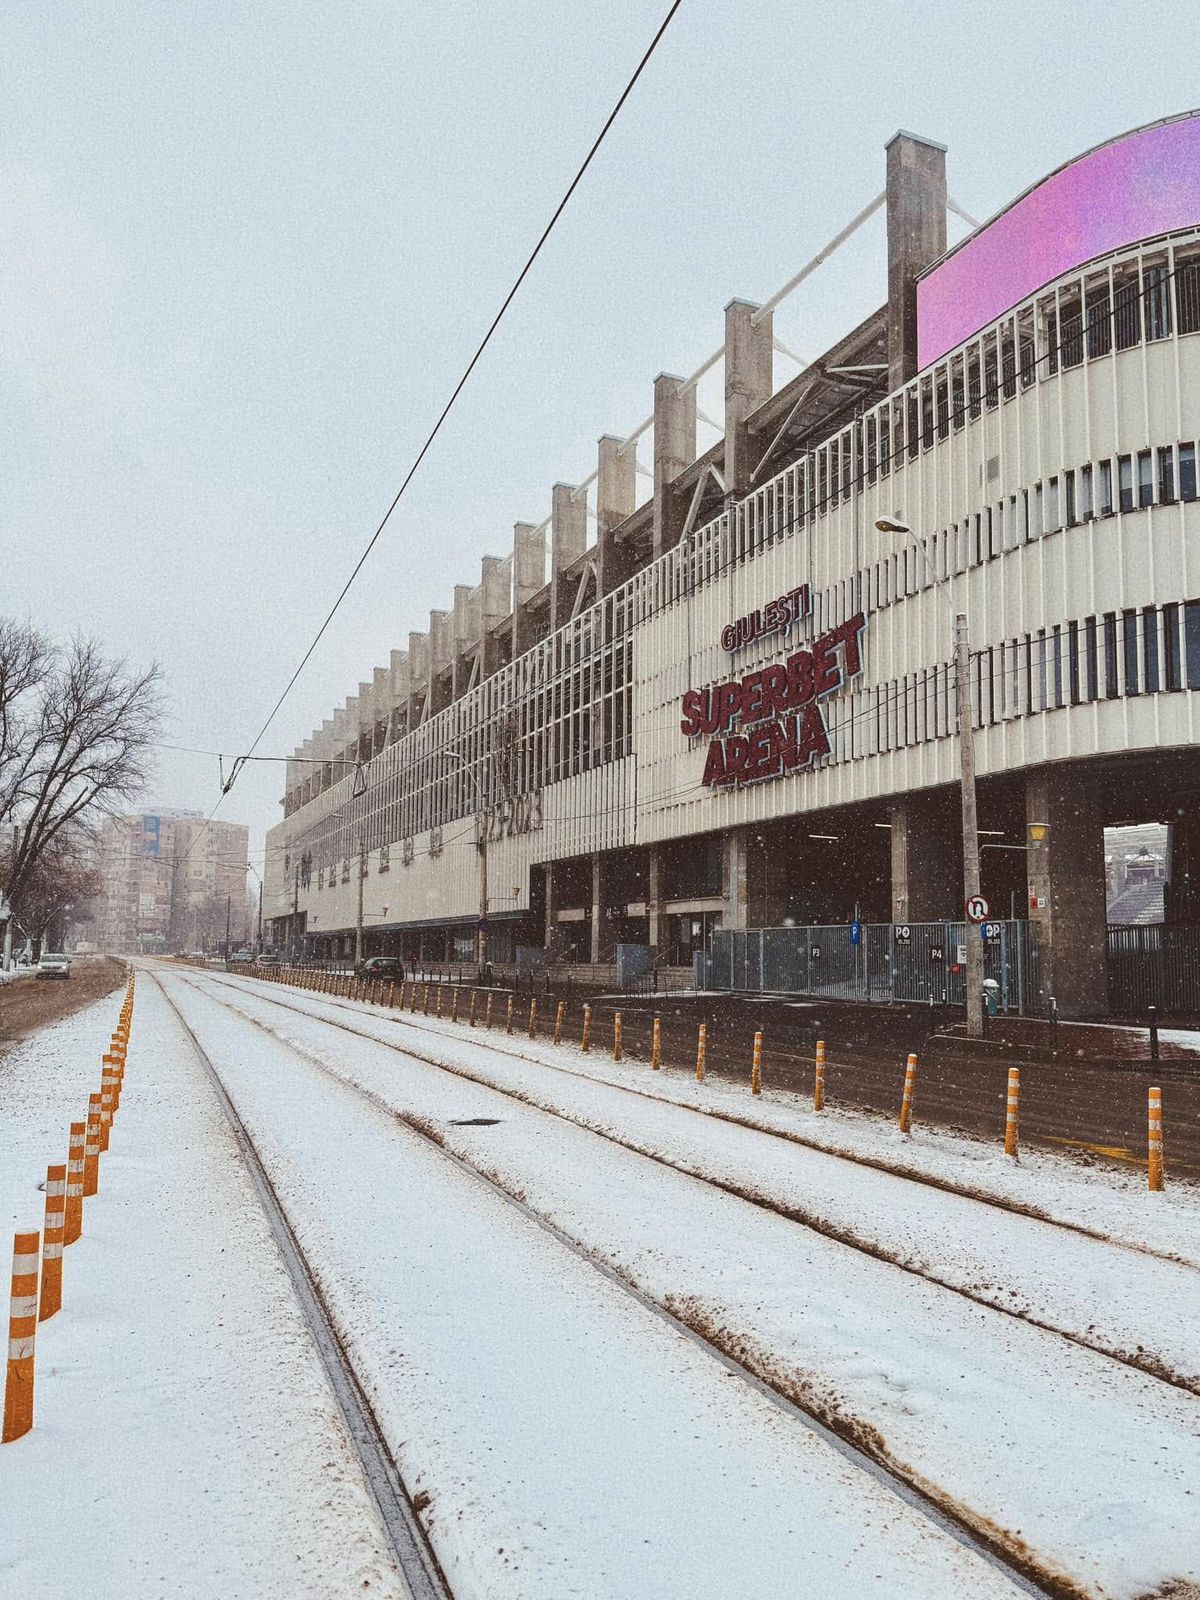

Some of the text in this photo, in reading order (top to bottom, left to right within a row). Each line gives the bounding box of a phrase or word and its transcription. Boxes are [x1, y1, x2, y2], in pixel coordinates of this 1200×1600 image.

[681, 612, 867, 738] SUPERBET
[702, 704, 833, 788] ARENA
[852, 926, 858, 940] P
[812, 948, 820, 957] P3
[932, 950, 942, 959] P4
